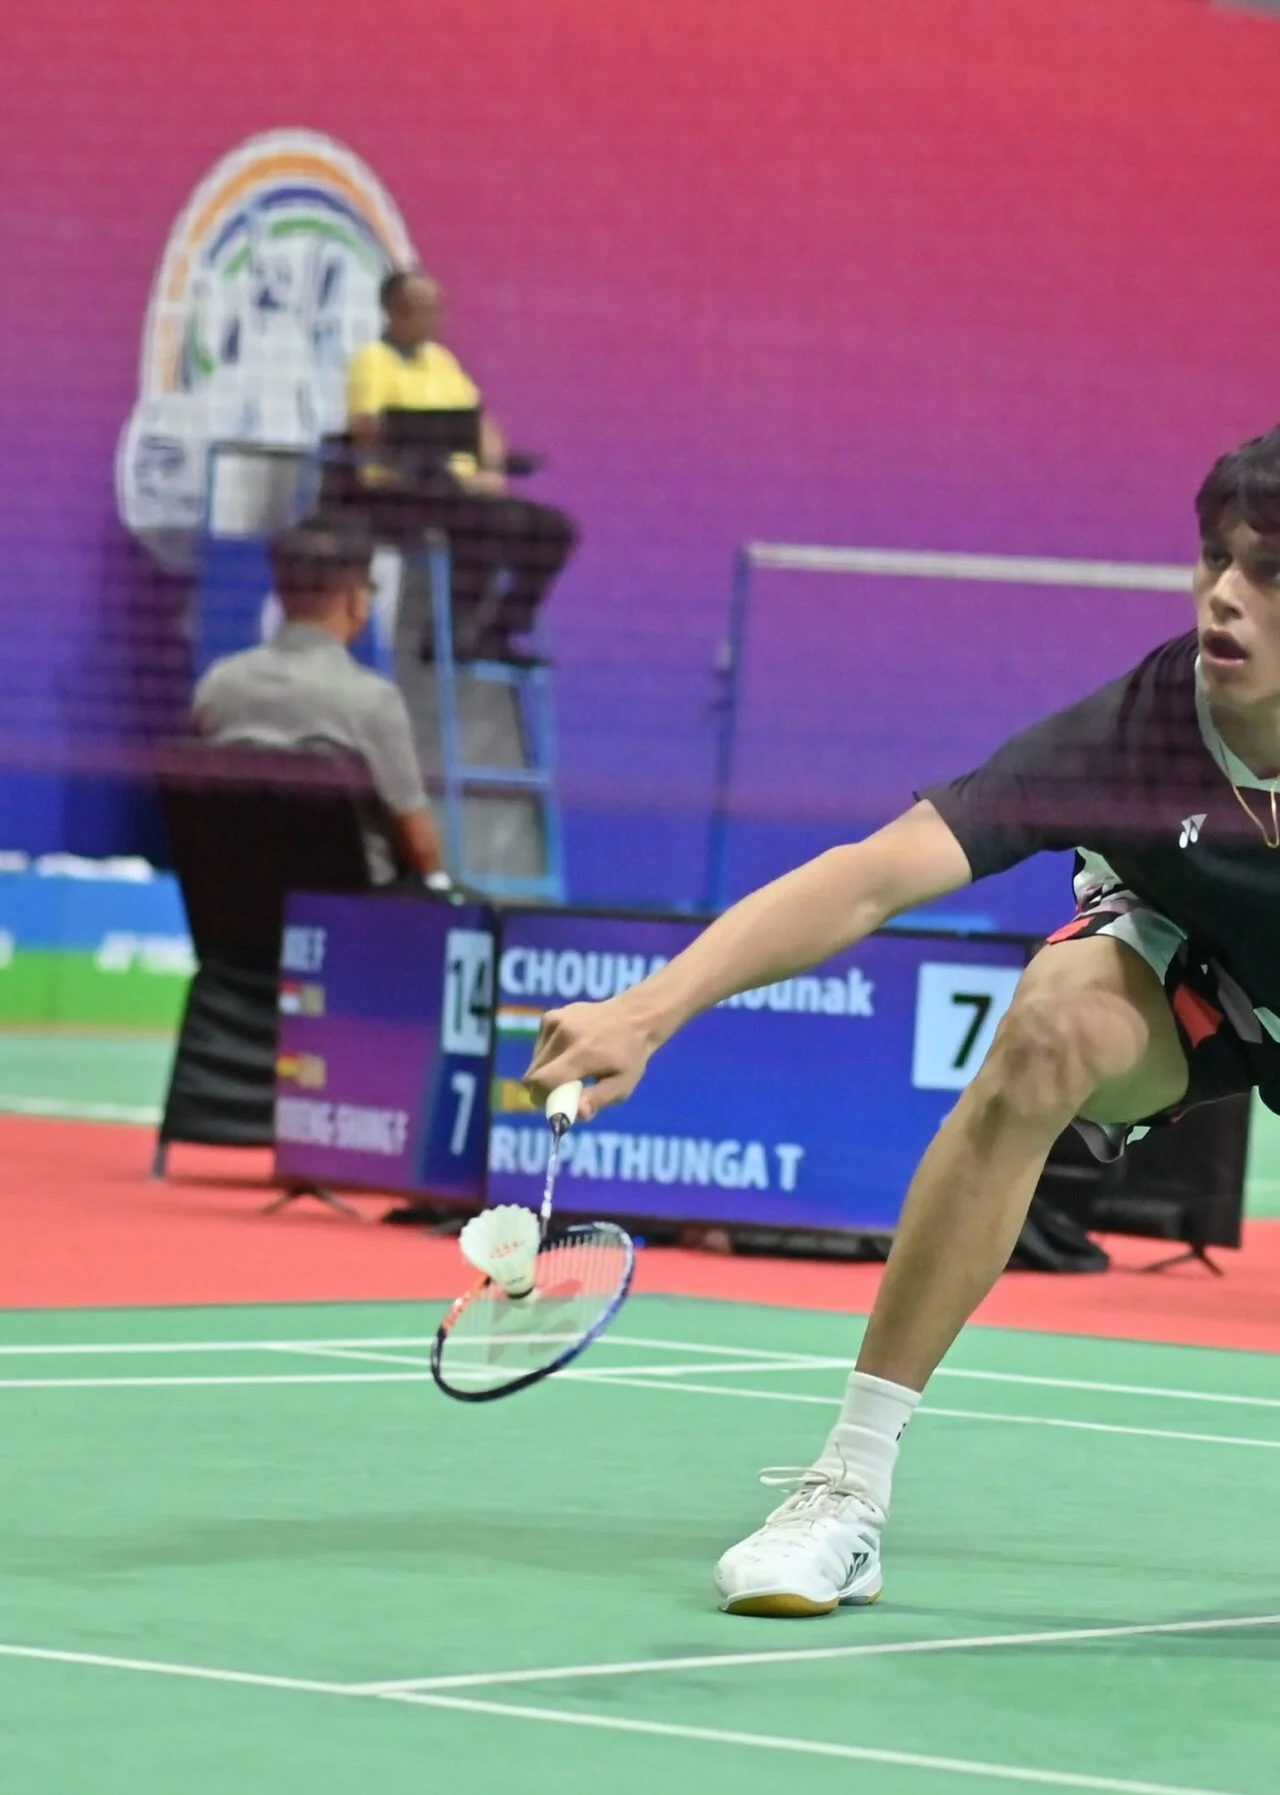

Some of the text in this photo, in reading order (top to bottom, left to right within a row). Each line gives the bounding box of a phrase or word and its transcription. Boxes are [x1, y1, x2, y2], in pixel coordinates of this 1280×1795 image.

[951, 992, 993, 1068] 7
[452, 1072, 477, 1155] 7
[490, 1125, 804, 1191] RUPATHUNGA T
